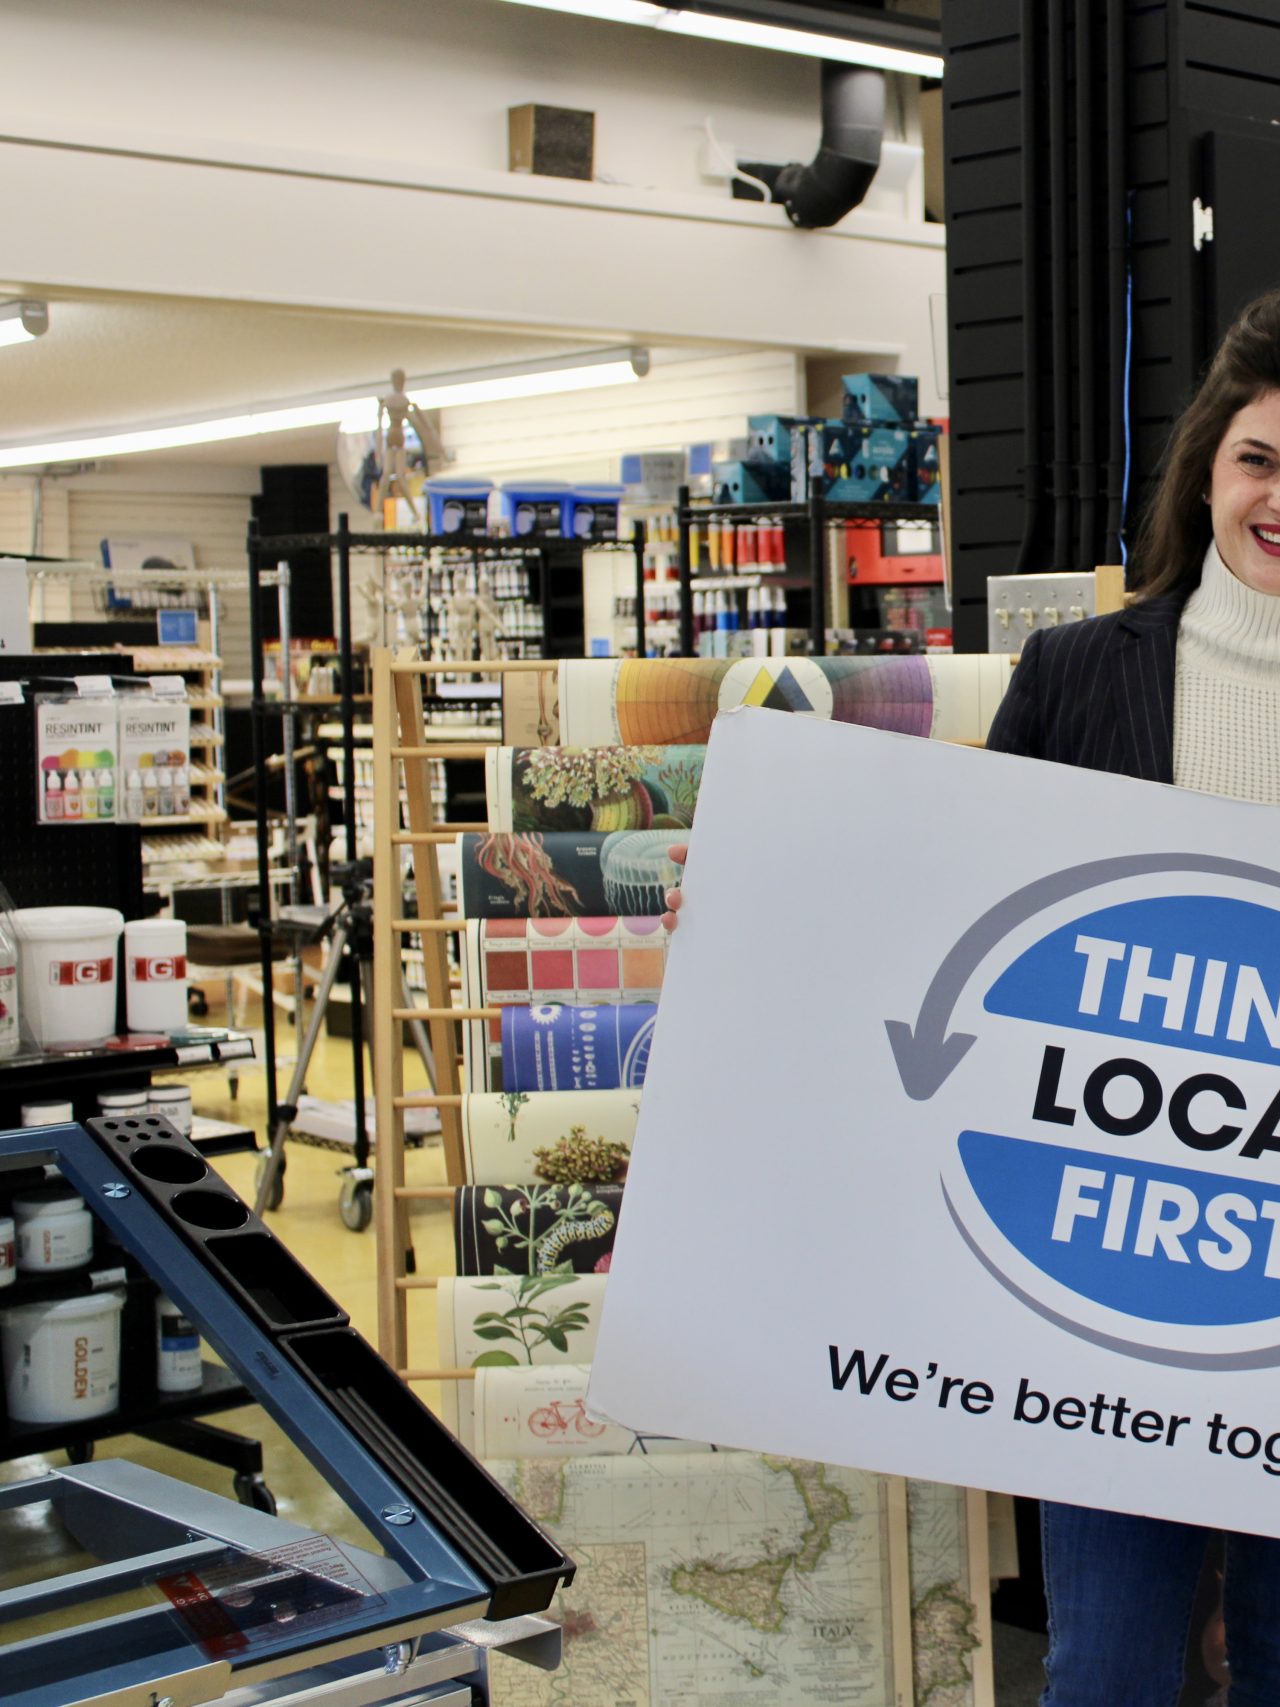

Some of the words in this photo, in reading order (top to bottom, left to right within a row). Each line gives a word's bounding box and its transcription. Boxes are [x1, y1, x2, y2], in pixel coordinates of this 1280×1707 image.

[45, 722, 102, 734] RESINTINT
[126, 721, 176, 733] RESINTINT
[74, 1336, 88, 1399] GOLDEN
[828, 1345, 995, 1416] We're
[1013, 1378, 1191, 1448] better
